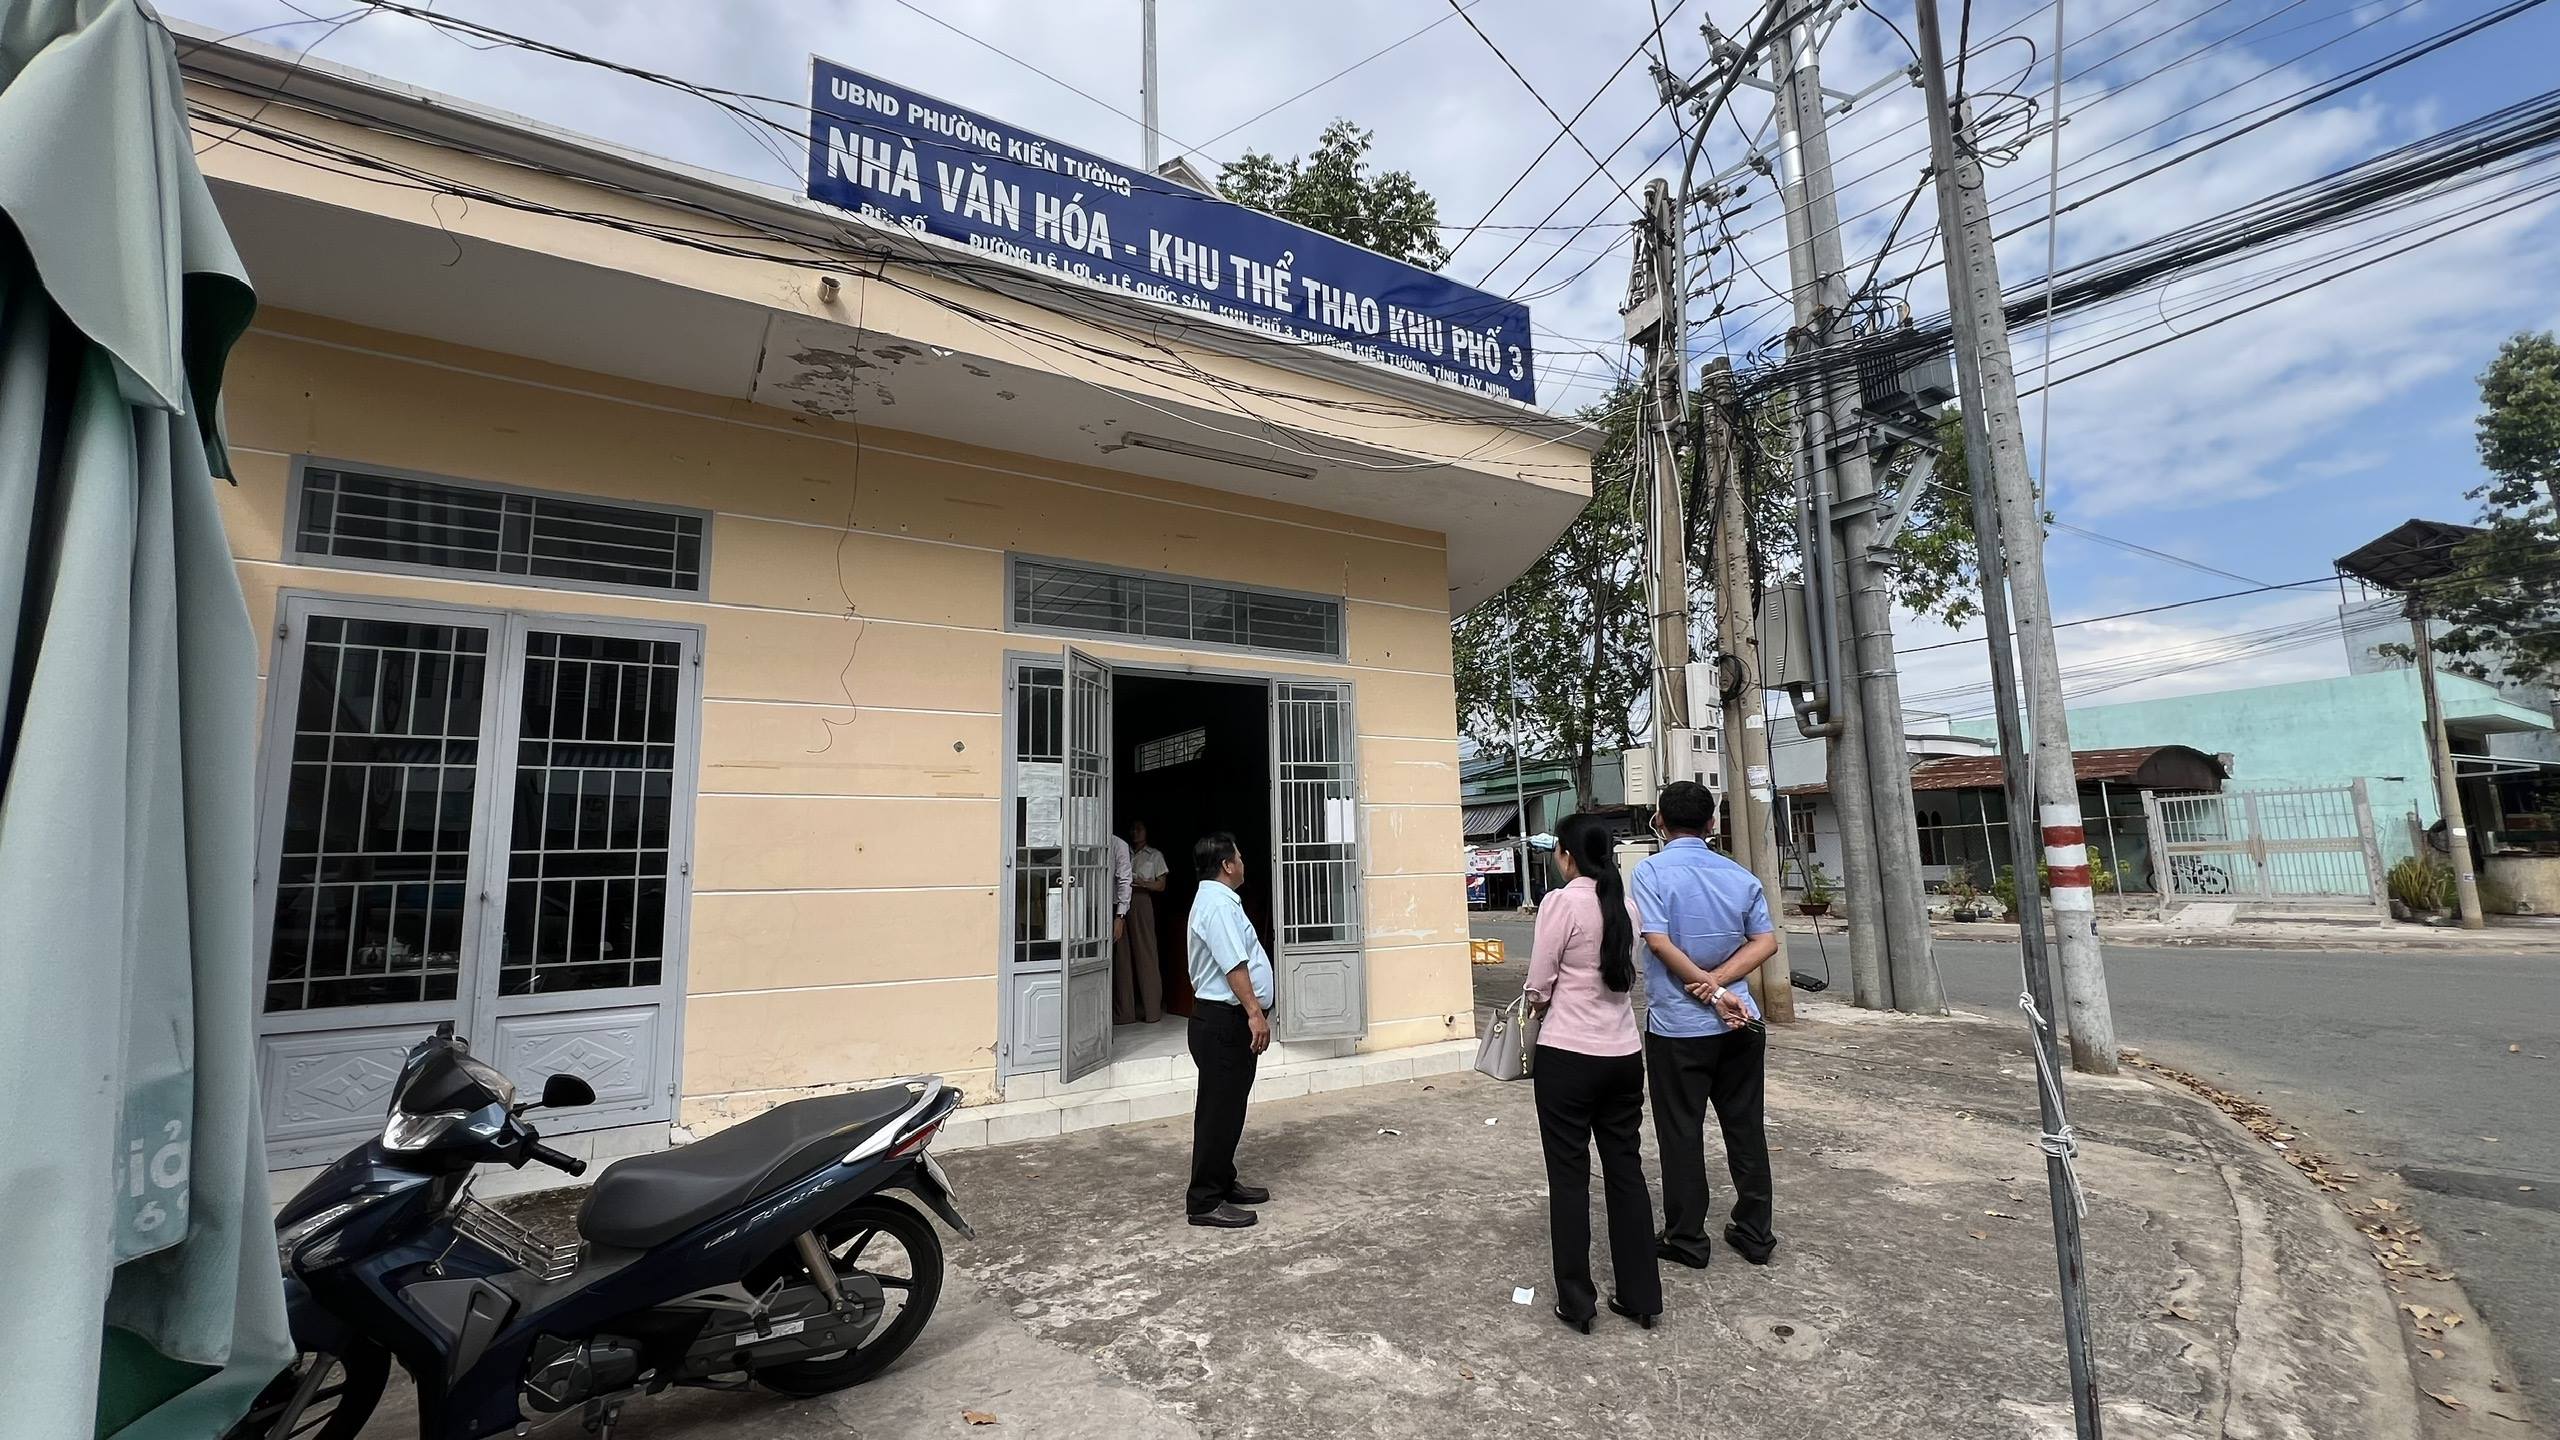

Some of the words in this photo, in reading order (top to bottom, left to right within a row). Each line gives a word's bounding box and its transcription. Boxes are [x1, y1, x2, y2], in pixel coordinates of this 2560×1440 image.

[831, 77, 899, 117] UBND
[908, 103, 1001, 154] PHƯỜNG
[1008, 137, 1058, 173] KIẾN
[1063, 157, 1131, 198] TƯỜNG
[827, 126, 922, 204] NHÀ
[936, 161, 1020, 232] VĂN
[1034, 192, 1113, 260] HÓA
[1149, 228, 1219, 291] KHU
[1229, 250, 1295, 314] THỂ
[1301, 276, 1380, 337] THAO
[1388, 304, 1445, 357] KHU
[1452, 325, 1503, 375] PHỐ
[1508, 344, 1525, 381] 3
[900, 215, 929, 232] SỐ
[969, 233, 1032, 263] ĐƯỜNG
[1036, 253, 1058, 269] LÊ
[1112, 273, 1132, 290] LÊ
[1219, 305, 1249, 325] KHU
[1253, 315, 1282, 335] PHỐ
[1356, 344, 1385, 363] KIẾN
[1433, 364, 1459, 384] TỈNH
[1461, 374, 1483, 391] TÂY
[1486, 381, 1510, 399] NINH
